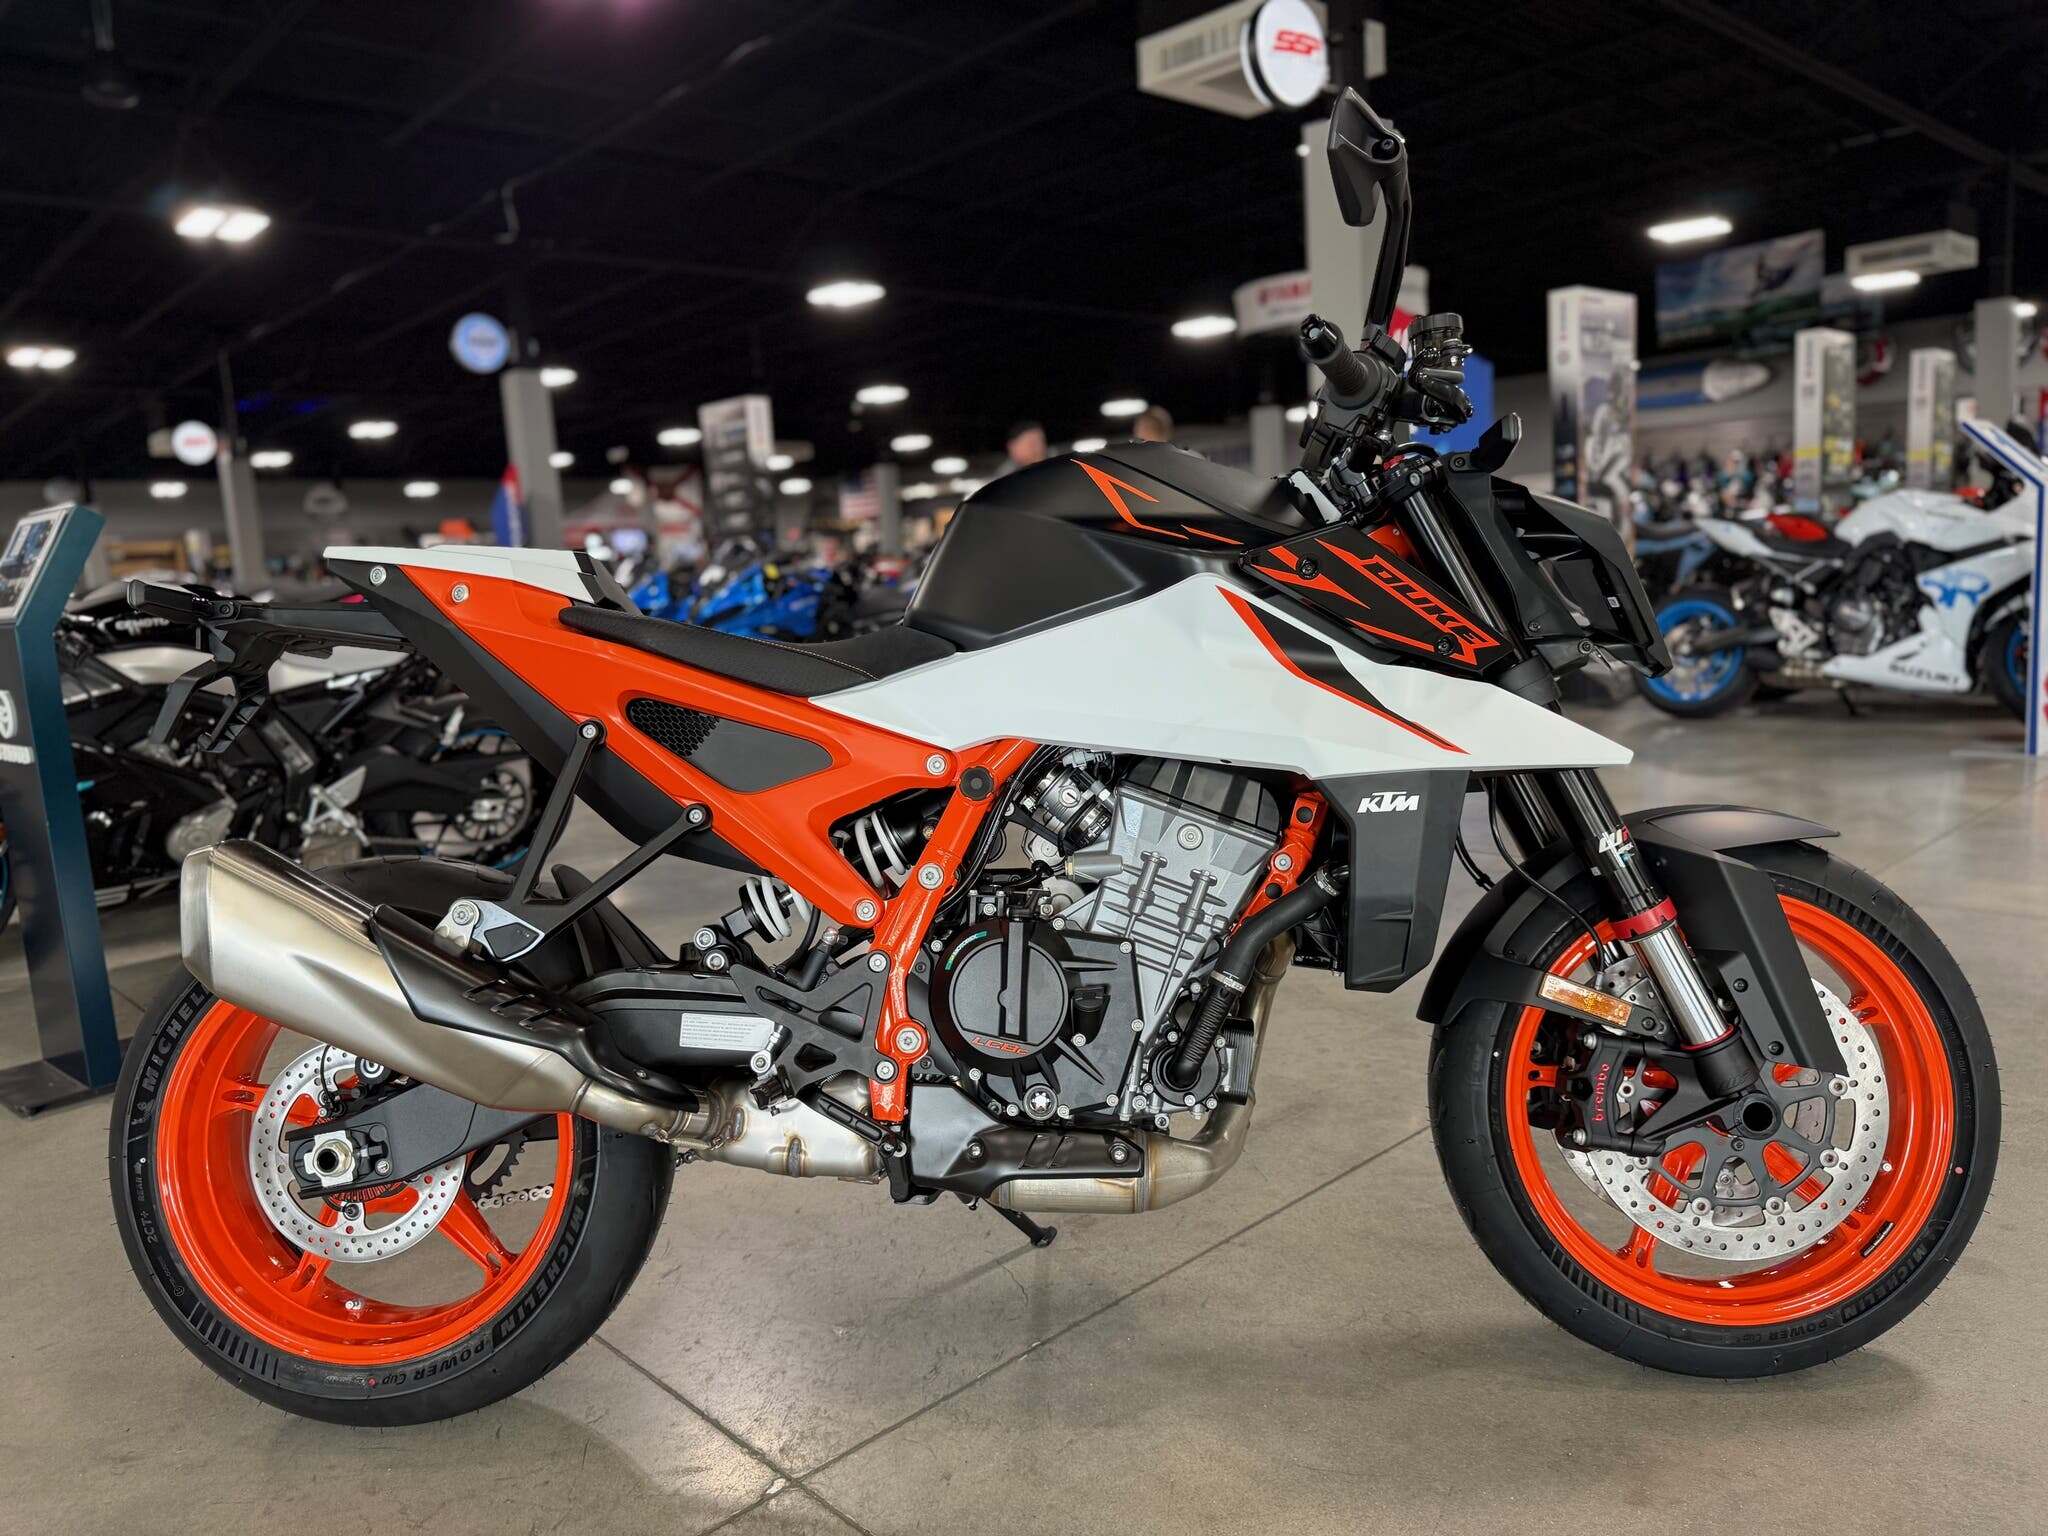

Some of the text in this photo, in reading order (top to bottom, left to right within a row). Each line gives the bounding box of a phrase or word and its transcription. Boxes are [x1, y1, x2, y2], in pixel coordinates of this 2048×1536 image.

[1360, 560, 1491, 646] DUKE
[1356, 790, 1420, 815] KTM
[141, 991, 206, 1093] MICHEL
[1592, 1062, 1610, 1122] brembo
[499, 1204, 586, 1339] MICHELIN
[1843, 1242, 1930, 1322] MICHELIN
[413, 1340, 485, 1382] POWER
[1767, 1316, 1829, 1343] POWER
